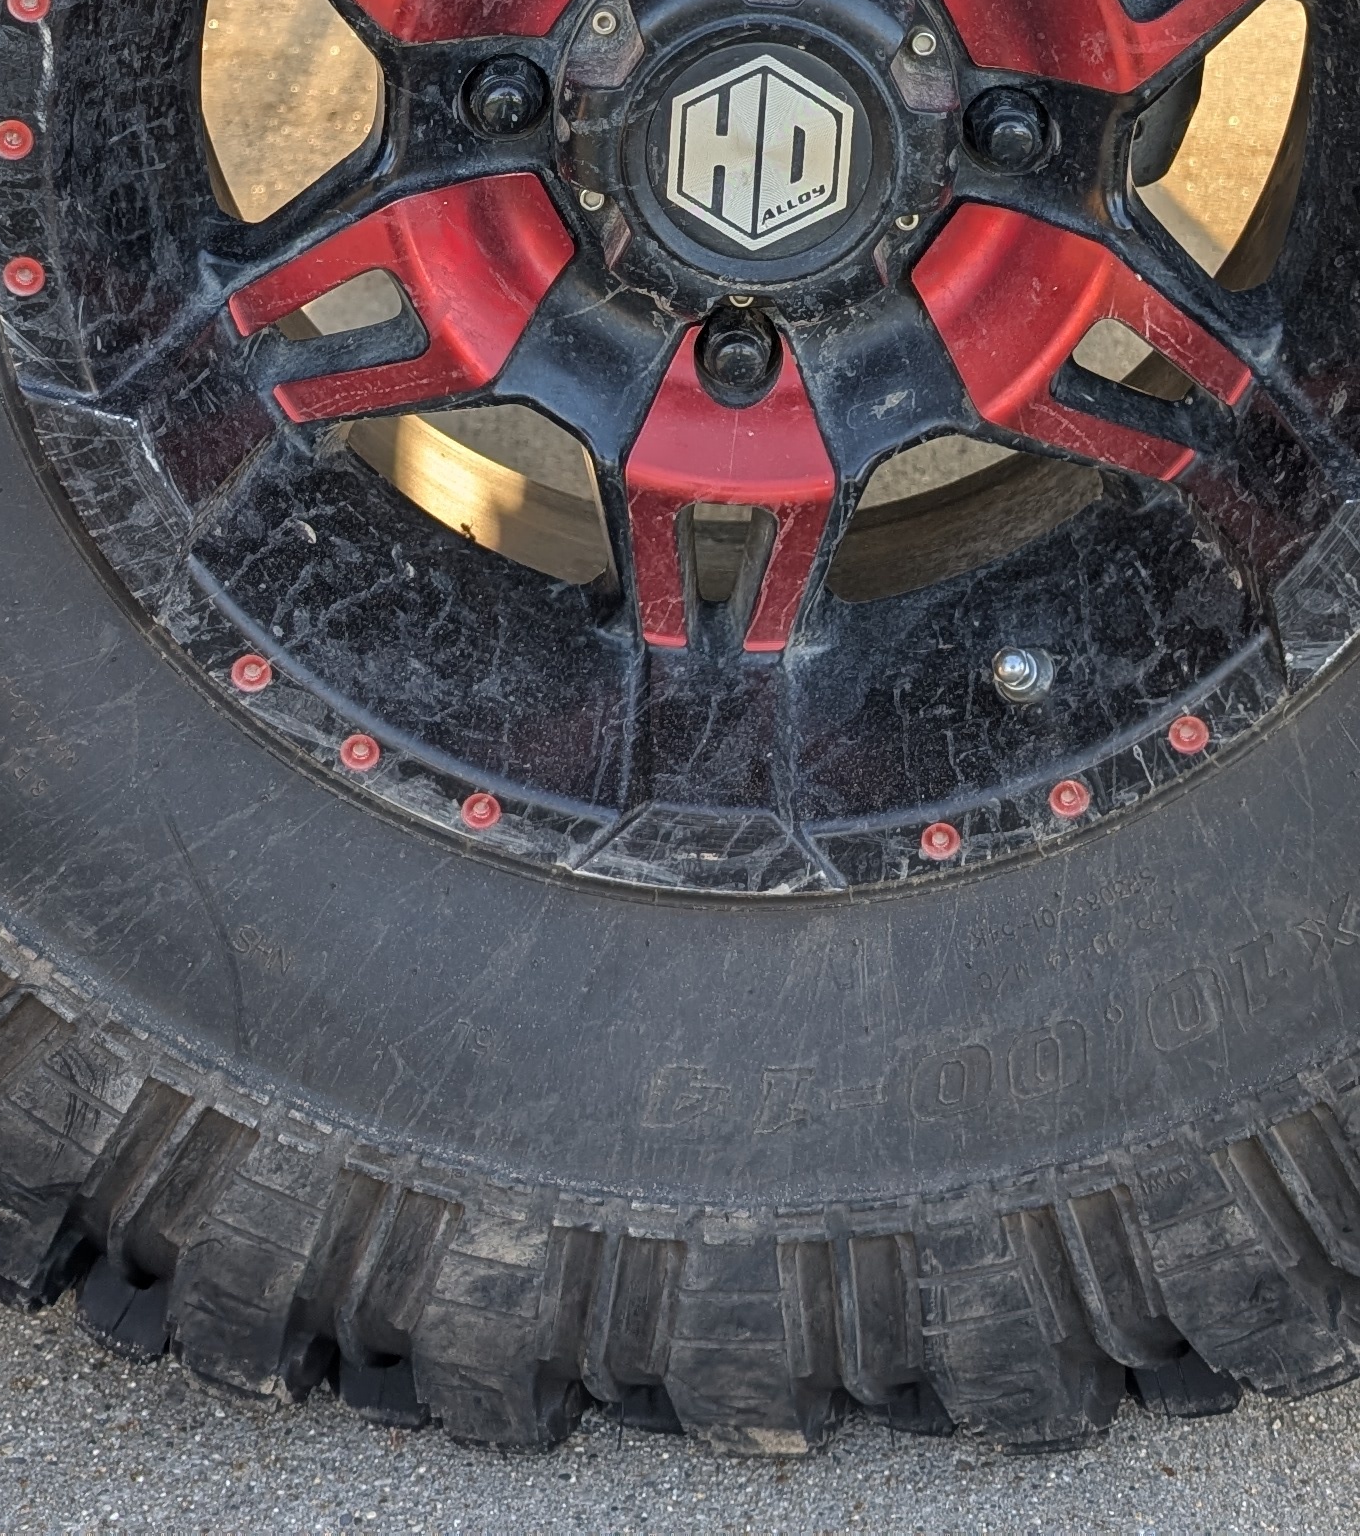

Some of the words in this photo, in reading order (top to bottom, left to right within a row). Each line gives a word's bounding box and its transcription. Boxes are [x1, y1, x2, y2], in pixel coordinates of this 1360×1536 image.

[680, 73, 838, 235] HD
[761, 183, 826, 226] ALLOY
[227, 919, 297, 978] NHS
